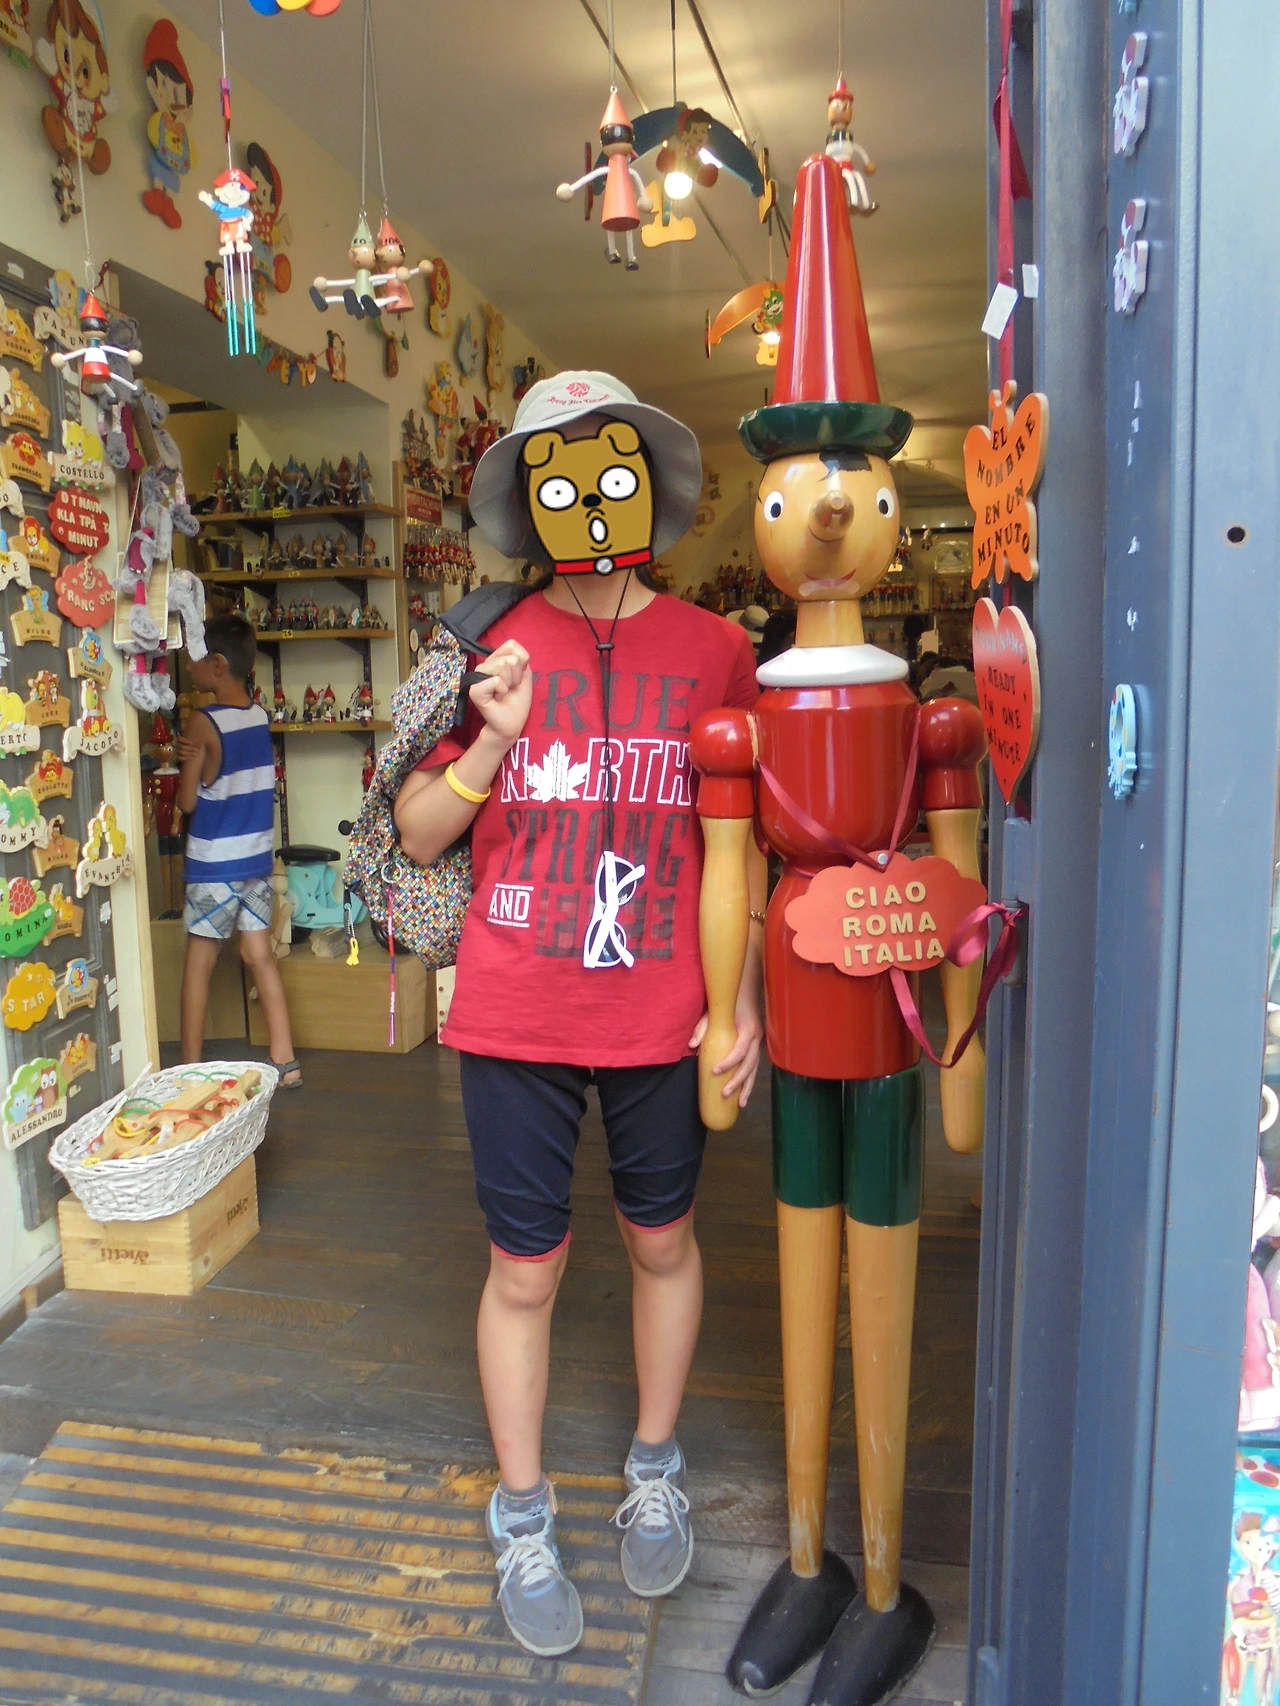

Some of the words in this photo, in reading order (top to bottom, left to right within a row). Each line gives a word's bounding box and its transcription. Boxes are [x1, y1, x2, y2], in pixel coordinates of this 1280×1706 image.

[976, 411, 1036, 488] NOMBRE
[992, 425, 1008, 451] EL
[59, 464, 105, 480] COSTELLO
[984, 500, 1001, 526] EN
[1005, 478, 1025, 505] UN
[68, 530, 99, 549] MINUT
[977, 522, 1031, 566] MINUTO
[974, 625, 998, 654] YOUR
[998, 627, 1029, 665] NAME
[987, 664, 1016, 695] READY
[532, 668, 699, 734] RUE
[983, 694, 995, 720] IN
[1002, 706, 1022, 730] ONE
[79, 730, 119, 752] JACOPO
[986, 727, 1022, 766] MINUTE
[501, 807, 691, 887] STRONG
[84, 853, 131, 883] EVANTHIA
[488, 882, 533, 929] AND
[845, 881, 927, 909] CIAO
[842, 911, 937, 938] ROMA
[843, 938, 945, 967] ITALIA
[10, 1108, 63, 1144] ALESSANDRO
